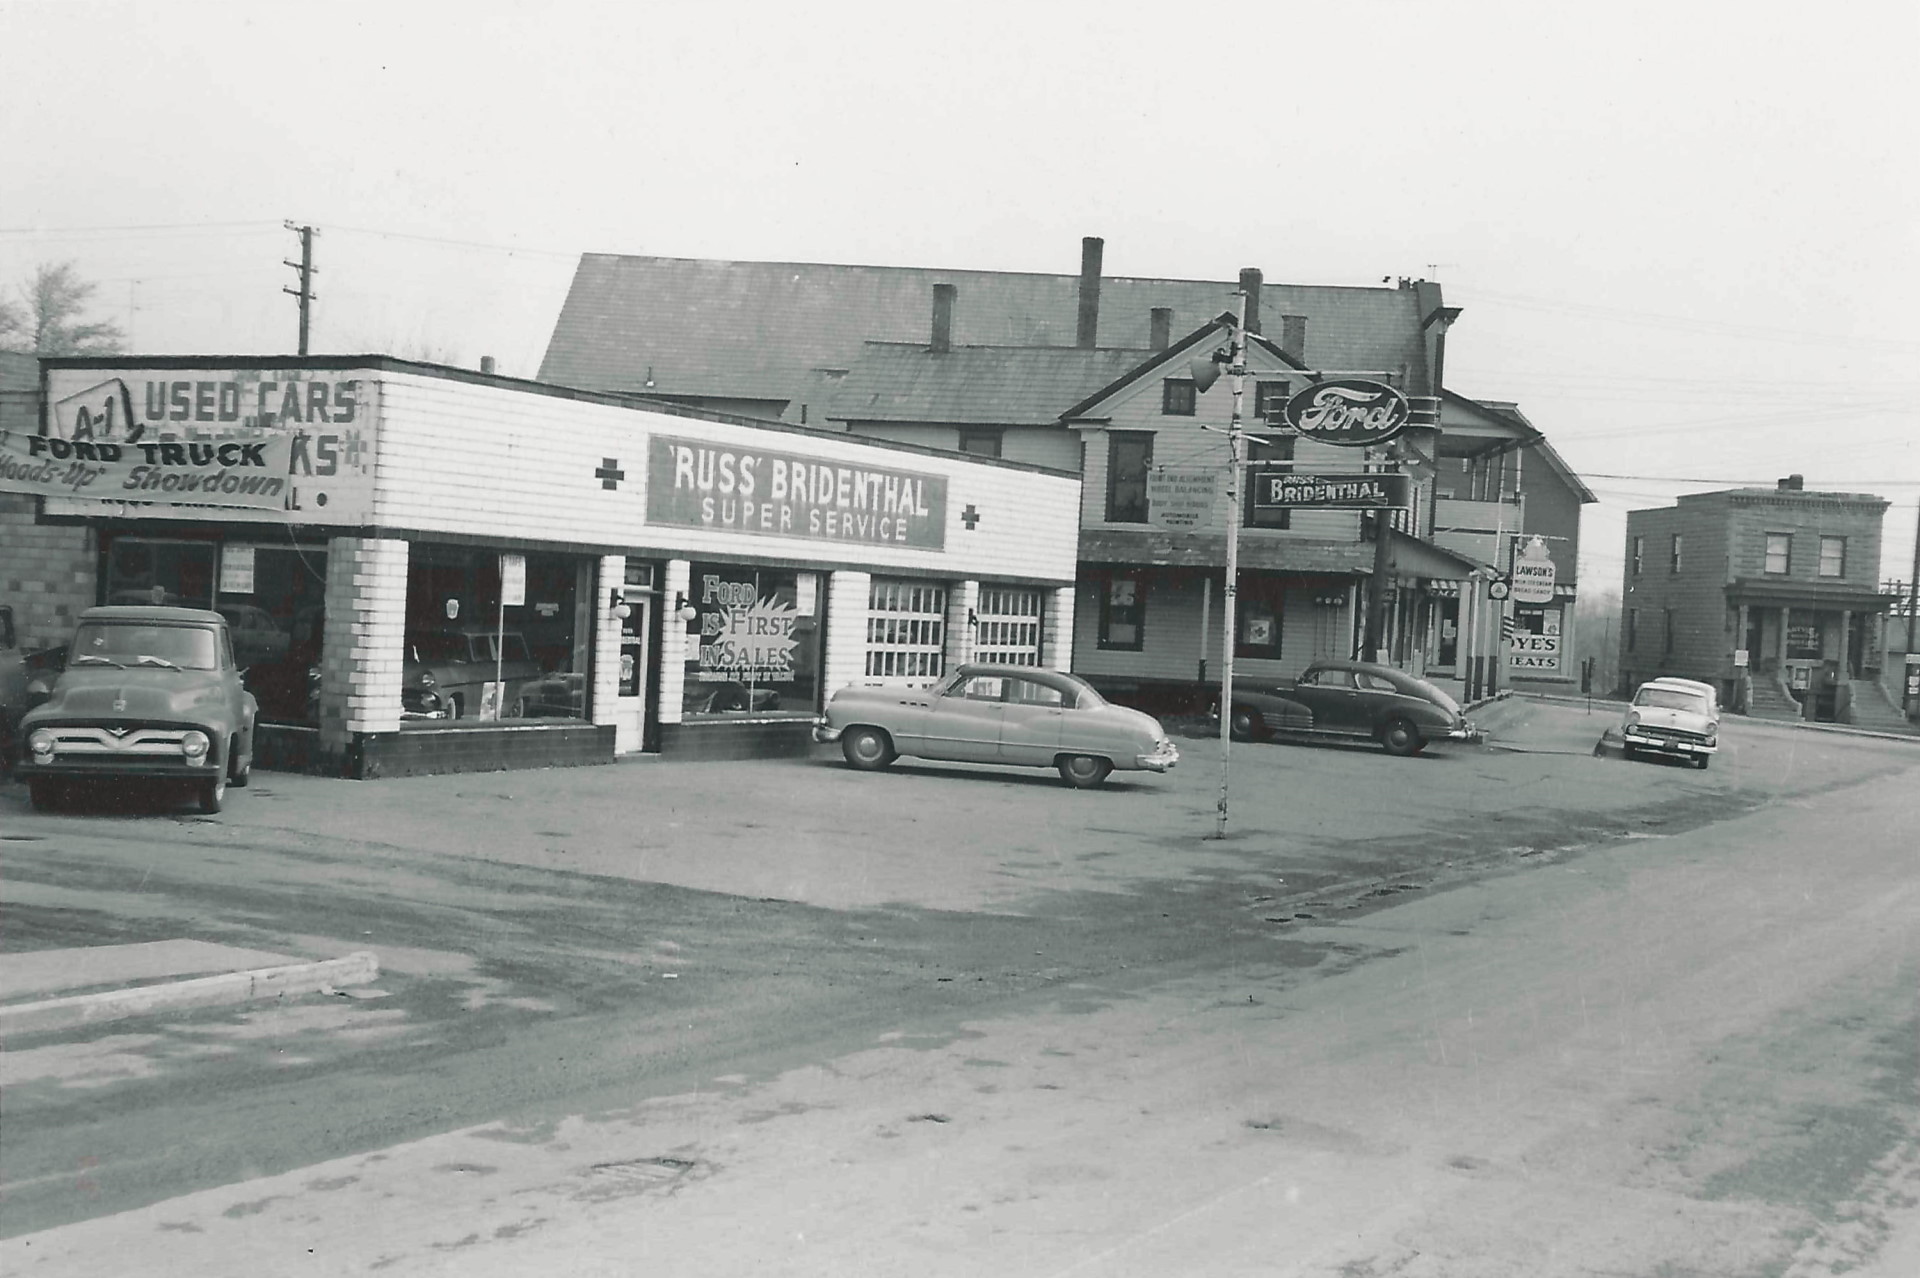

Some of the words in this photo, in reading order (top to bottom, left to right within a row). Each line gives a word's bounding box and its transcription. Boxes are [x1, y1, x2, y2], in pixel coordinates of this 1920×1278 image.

[146, 381, 239, 423] USED
[258, 381, 355, 424] CARS
[1299, 386, 1399, 430] Ford
[27, 435, 122, 462] FORD
[137, 443, 266, 467] TRUCK
[123, 466, 284, 497] Showdown
[771, 459, 928, 517] BRIDENTHAL
[701, 497, 792, 530] SUPER
[809, 509, 907, 541] SERVICE
[702, 575, 755, 605] FORD
[702, 613, 719, 636] IS
[730, 609, 792, 636] FIRST
[700, 645, 719, 667] IN
[722, 641, 789, 667] SALES
